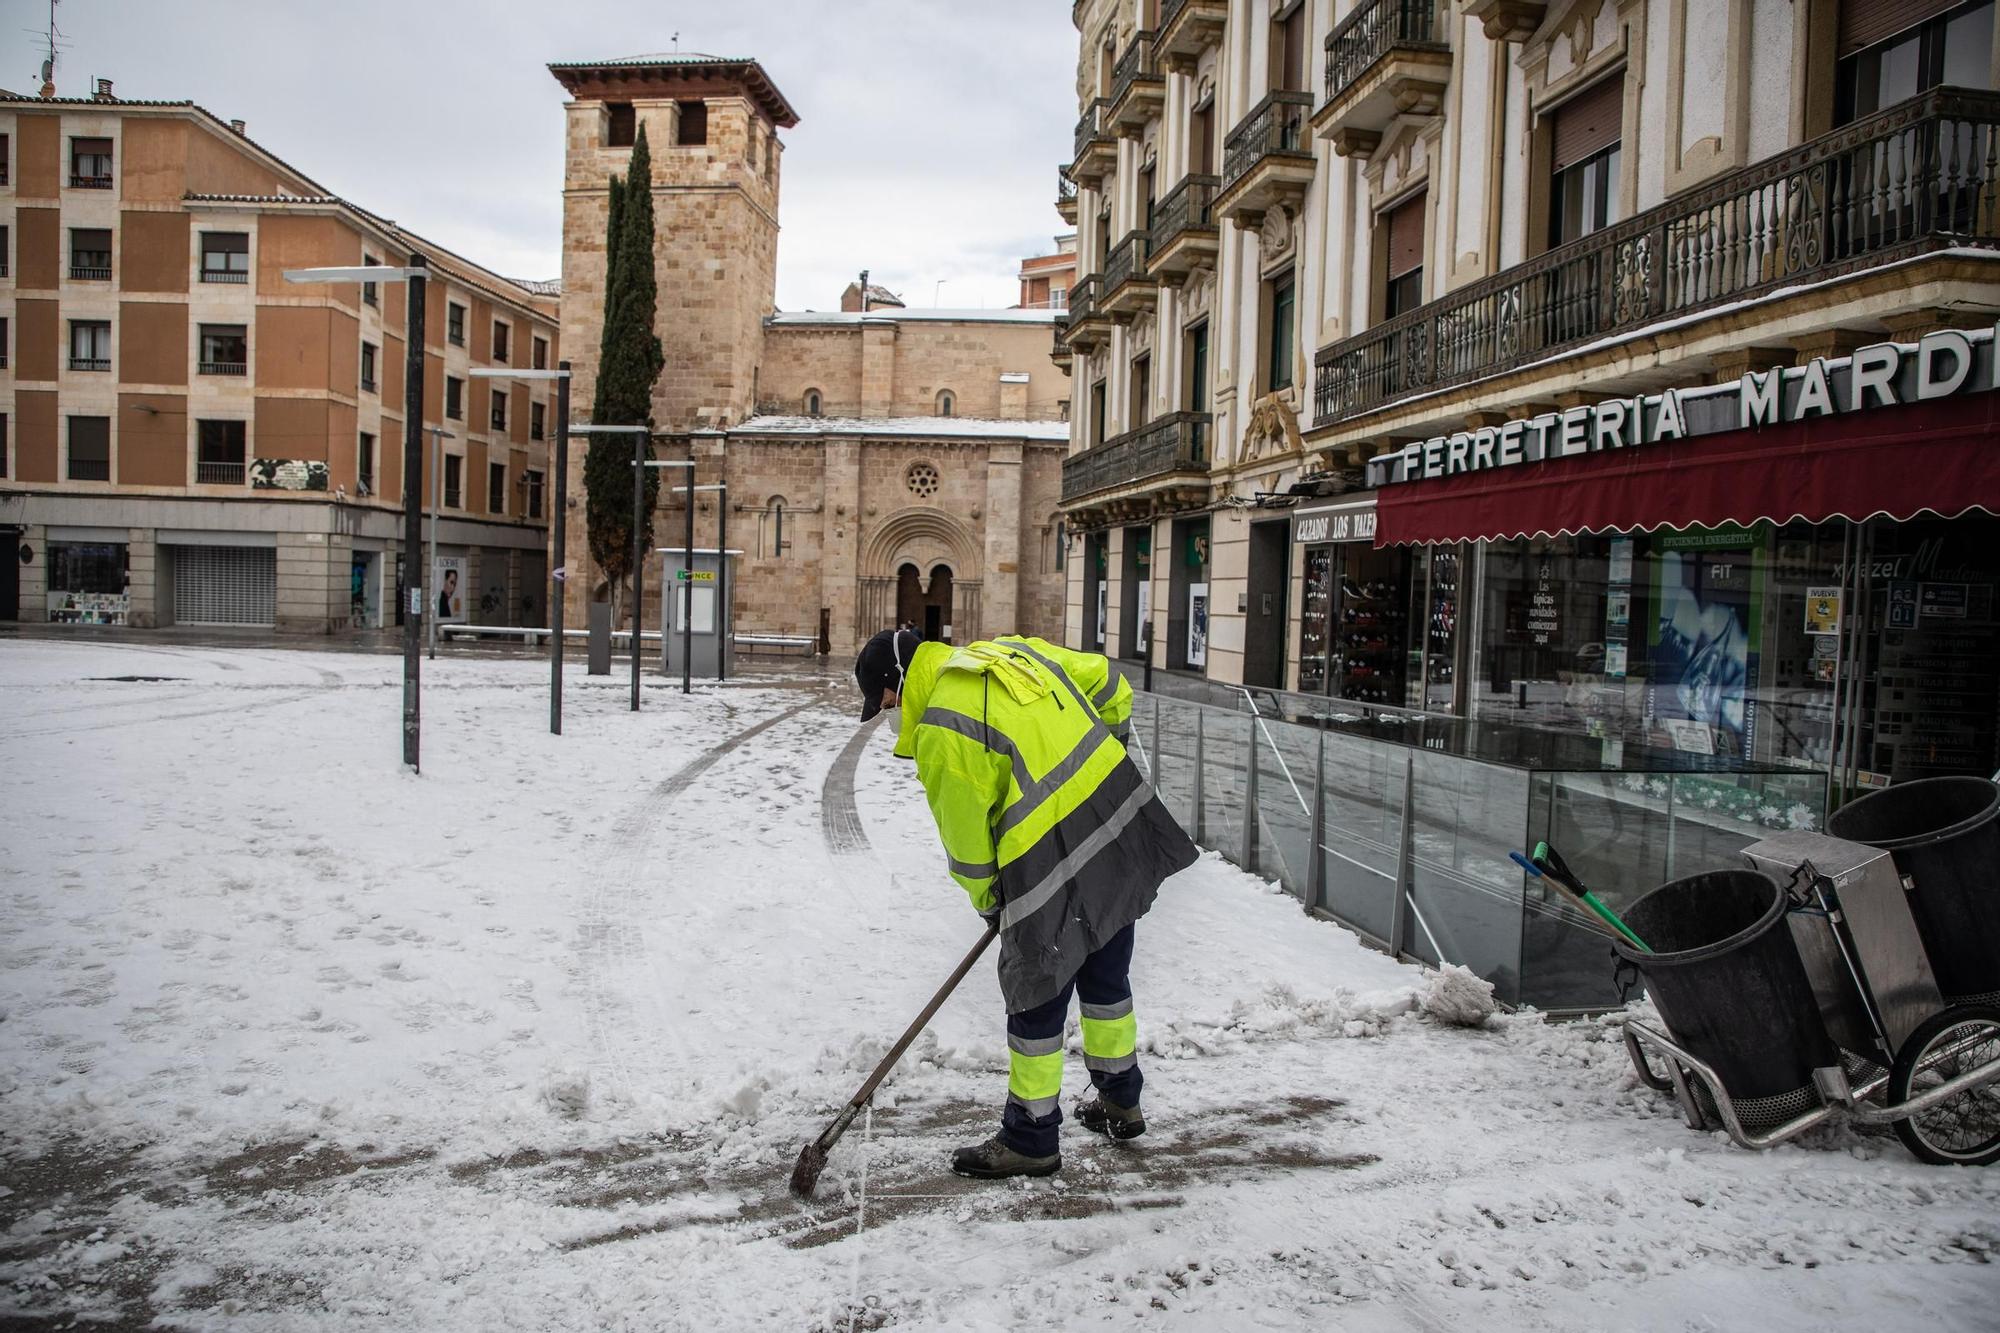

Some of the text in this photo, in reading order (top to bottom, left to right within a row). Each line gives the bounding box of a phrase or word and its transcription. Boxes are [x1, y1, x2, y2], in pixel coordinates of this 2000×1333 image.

[1402, 320, 2000, 481] FERRETERIA MARD
[1332, 515, 1349, 539] LOS
[1663, 536, 1704, 547] EFICIENCIA
[1711, 564, 1733, 579] FIT
[1832, 557, 1902, 582] xyazel
[1539, 580, 1550, 591] Las
